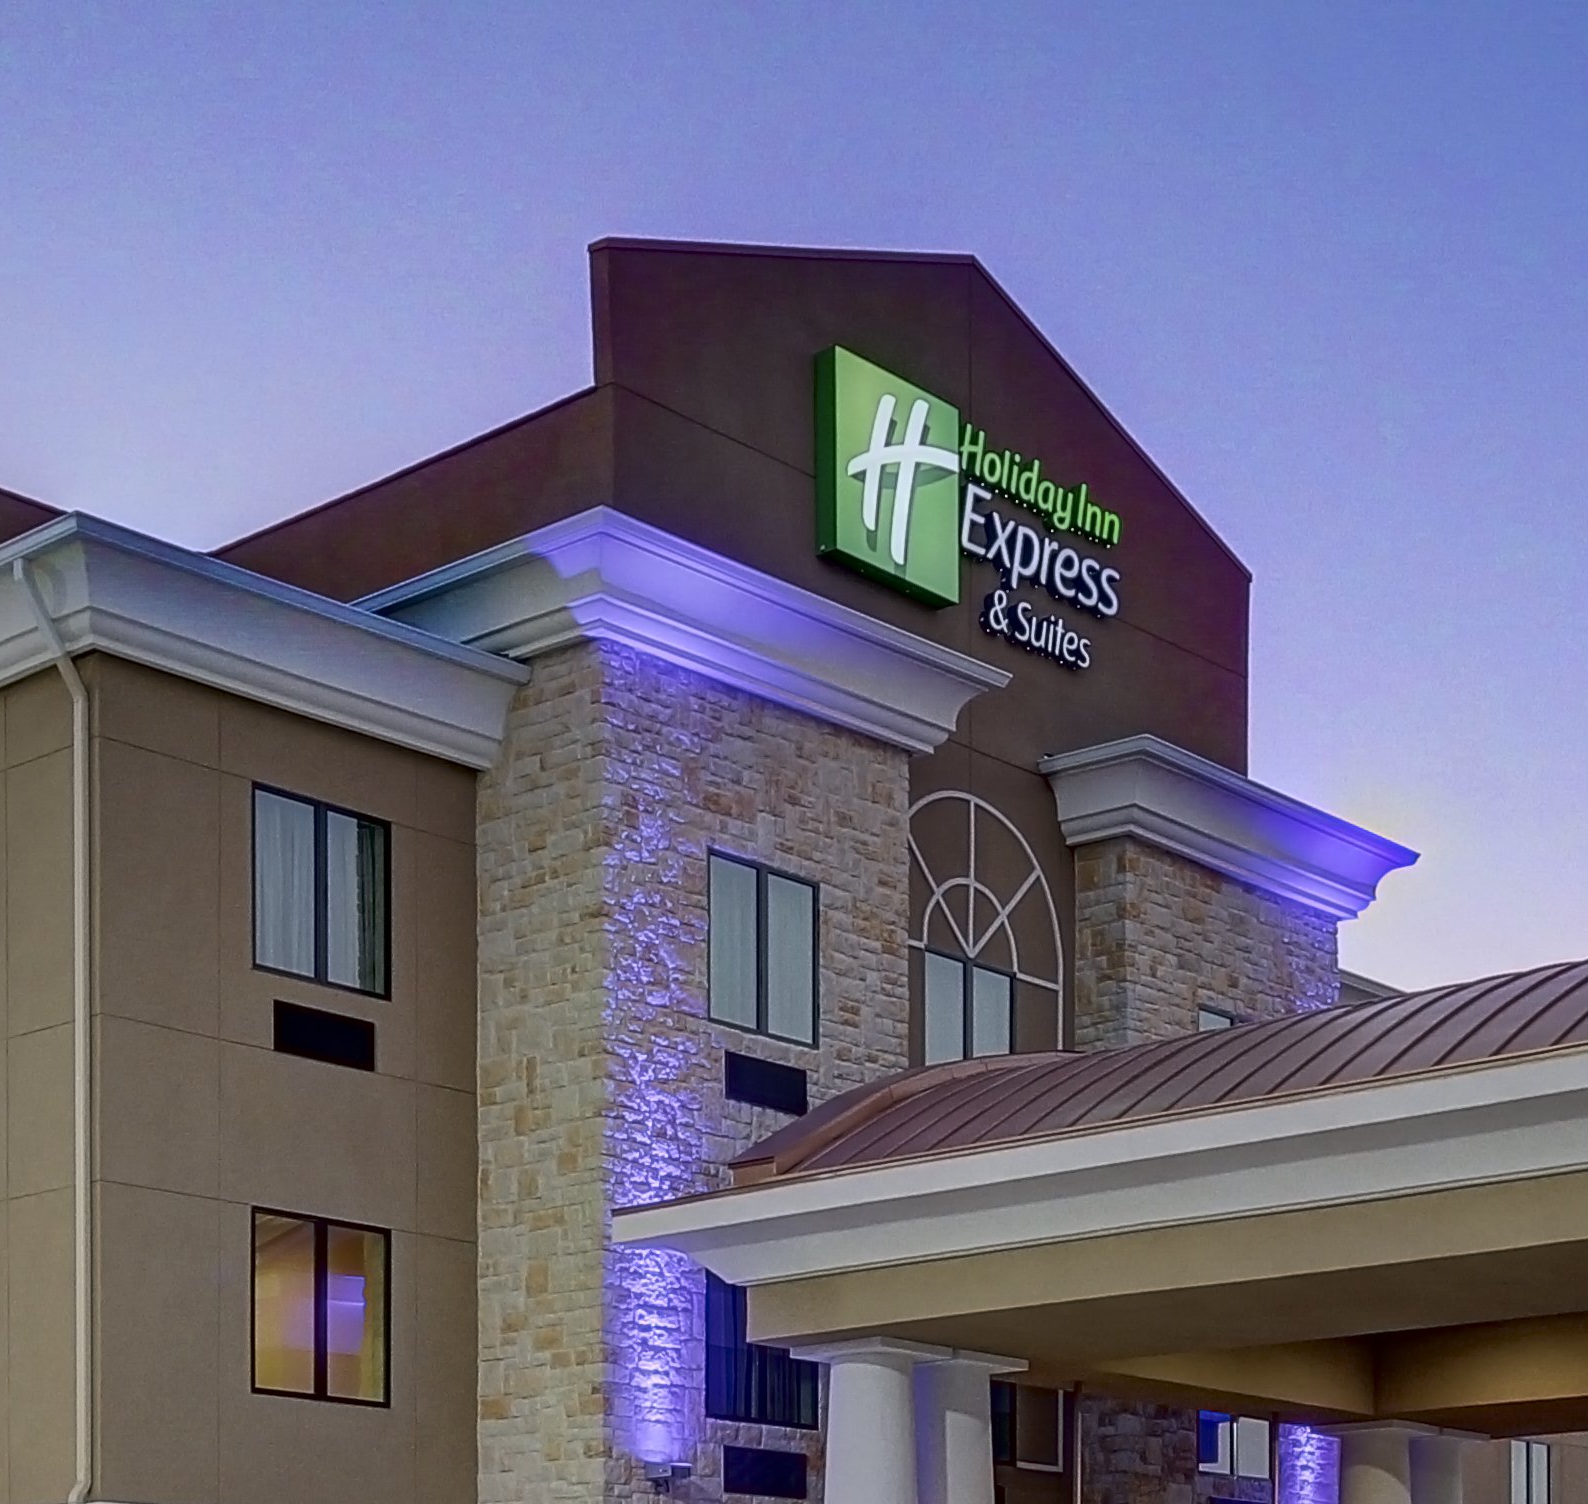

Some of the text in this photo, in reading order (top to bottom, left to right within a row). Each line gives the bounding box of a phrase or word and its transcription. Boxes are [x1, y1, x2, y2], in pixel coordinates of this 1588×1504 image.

[960, 422, 1122, 545] Holiday Inn
[961, 482, 1121, 616] Express
[988, 589, 1092, 669] & Suites
